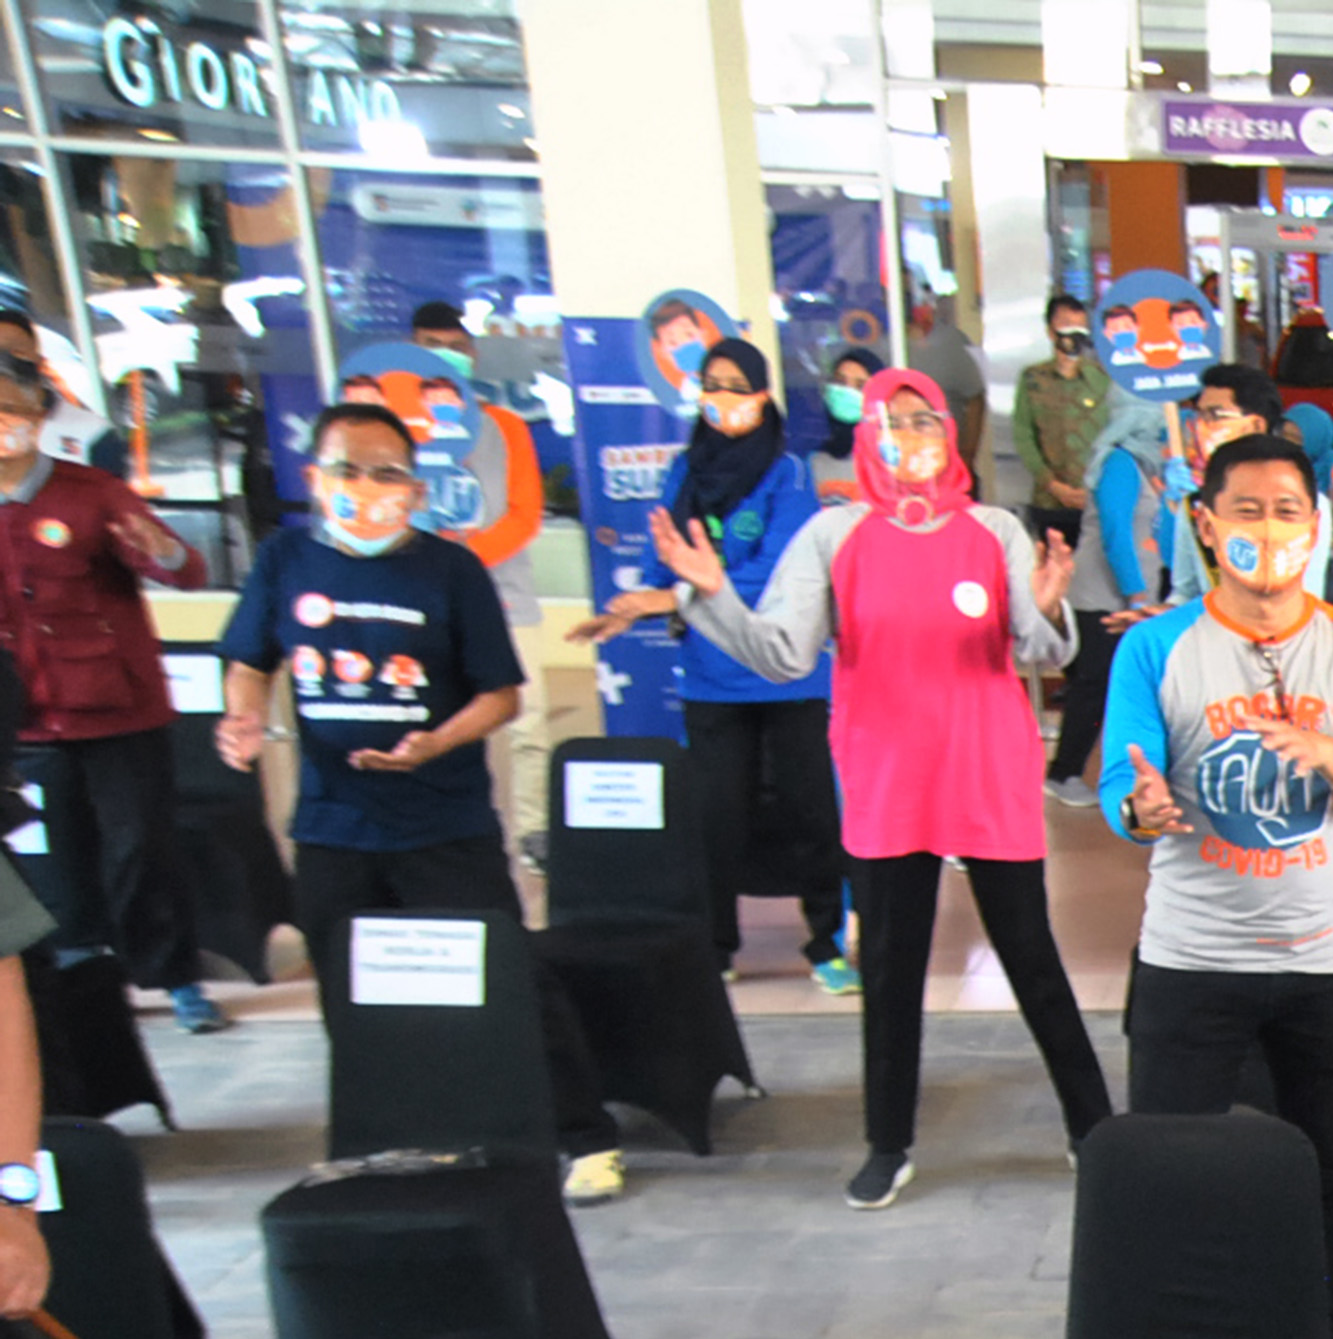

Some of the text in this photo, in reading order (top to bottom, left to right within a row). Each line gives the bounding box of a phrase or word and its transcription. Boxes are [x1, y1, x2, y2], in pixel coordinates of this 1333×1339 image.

[103, 17, 401, 128] GIORANO
[1168, 114, 1297, 142] RAFFLESIA
[1200, 835, 1329, 879] COVID-19
